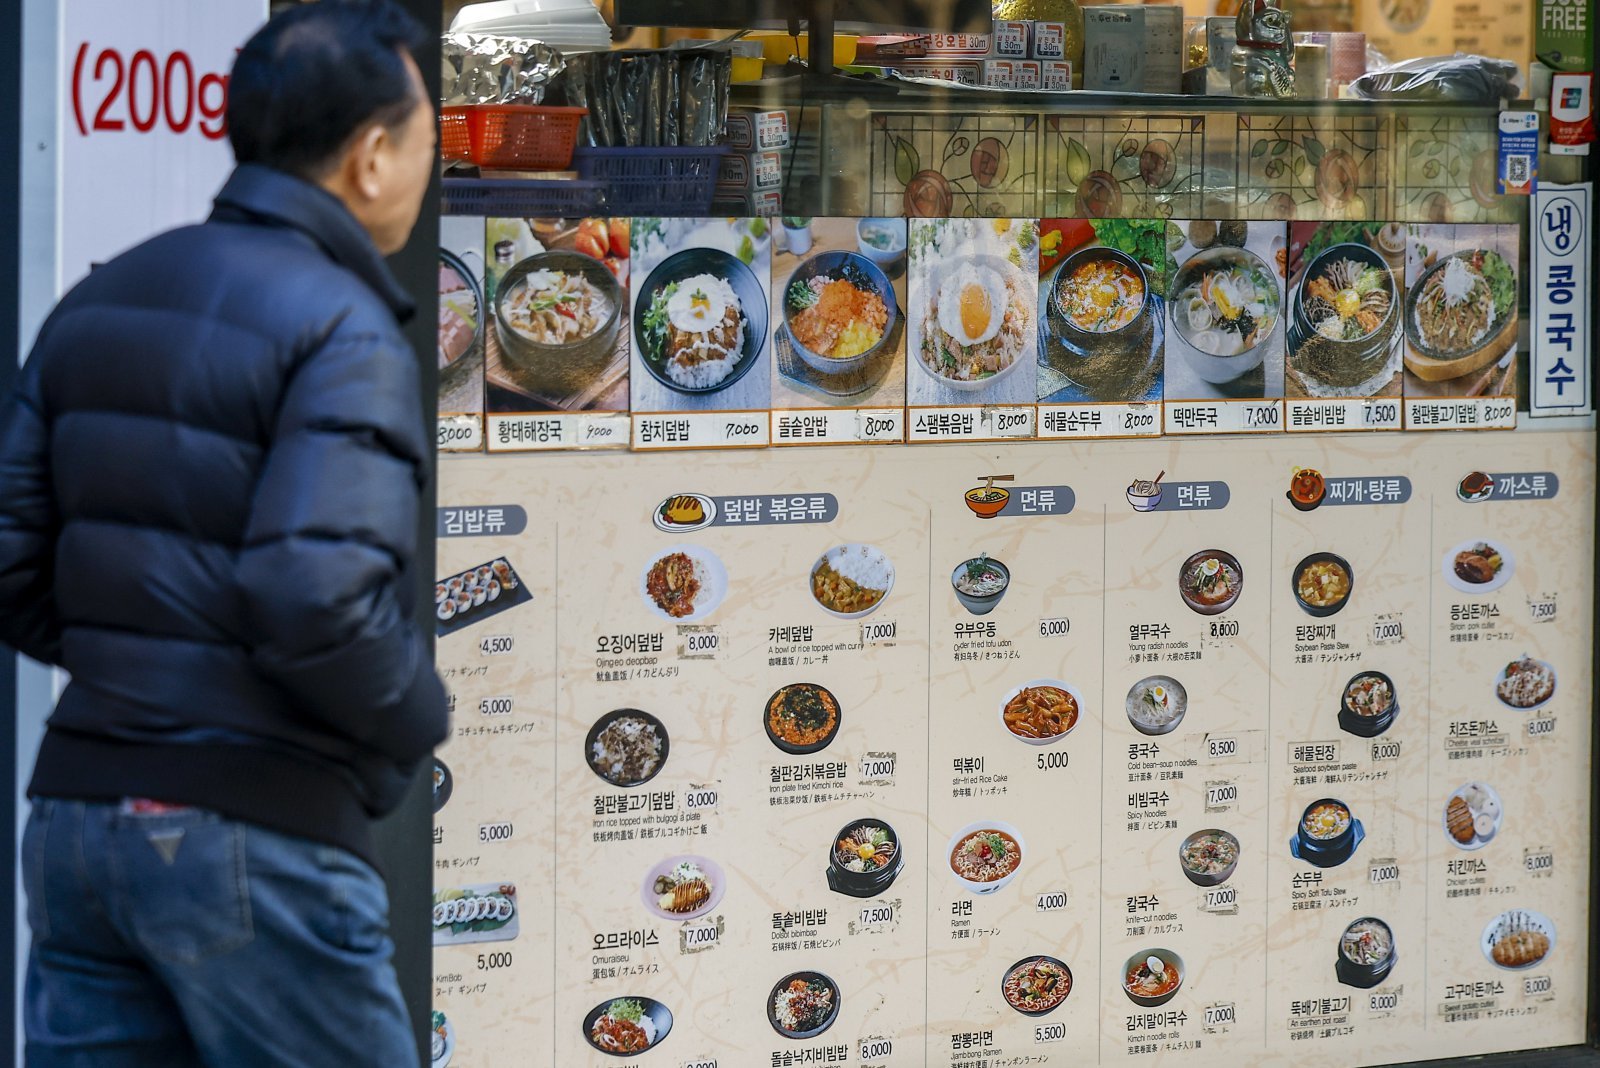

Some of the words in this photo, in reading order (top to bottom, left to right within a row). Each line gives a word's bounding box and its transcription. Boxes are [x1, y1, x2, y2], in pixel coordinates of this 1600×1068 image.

[1542, 6, 1586, 30] FREE
[969, 36, 986, 48] 30m
[1004, 41, 1021, 50] 30m
[1043, 42, 1059, 51] 30m
[72, 42, 241, 141] (200g
[994, 80, 1010, 88] 30m
[1020, 81, 1036, 89] 30m
[1051, 82, 1067, 90] 30m
[767, 133, 783, 142] 30m
[762, 172, 779, 181] 30m
[1545, 205, 1571, 250] 냉
[1545, 264, 1576, 396] 콩국수
[1044, 411, 1102, 432] 해물순두부
[1124, 412, 1154, 429] 8,000
[1173, 407, 1218, 428] 떡만두국
[1246, 408, 1278, 428] 7,000
[1292, 405, 1346, 425] 돌솥비빔밥
[1364, 405, 1397, 423] 7,500
[1411, 404, 1477, 424] 철판불고기덮밥
[498, 420, 563, 444] 황태해장국
[640, 420, 690, 442] 참치덮밥
[778, 416, 829, 438] 돌솥알밥
[865, 416, 895, 437] 8,000
[915, 414, 974, 436] 스팸볶음밥
[1499, 476, 1547, 497] 까스류
[1020, 489, 1056, 512] 면류
[1177, 485, 1212, 507] 면류
[724, 499, 762, 523] 덮밥
[769, 497, 827, 521] 볶음류
[444, 508, 506, 534] 김밥류
[1450, 603, 1500, 621] 등심돈까스
[1531, 603, 1554, 618] 7,500
[769, 625, 813, 643] 카레덮밥
[865, 624, 892, 641] 7,000
[954, 621, 997, 639] 유부우동
[1040, 620, 1067, 637] 6,000
[1129, 623, 1171, 640] 열무국수
[1295, 624, 1336, 641] 된장찌개
[1375, 624, 1399, 640] 7,000
[482, 637, 512, 654] 4,500
[596, 632, 664, 654] 오징어덮밥
[688, 635, 717, 651] 8,000
[775, 645, 789, 654] bowl
[791, 645, 797, 653] of
[798, 644, 811, 652] rice
[812, 643, 833, 654] topped
[835, 643, 847, 651] with
[970, 640, 985, 649] fried
[986, 640, 996, 648] tofu
[998, 639, 1012, 647] udon
[1129, 643, 1146, 652] Young
[1147, 642, 1164, 650] radish
[1165, 640, 1189, 649] noodles
[1295, 643, 1319, 653] Soybean
[1320, 643, 1335, 651] Paste
[1336, 642, 1350, 650] Stew
[985, 650, 1020, 660] きつねうどん
[1320, 652, 1362, 663] テンジャンチゲ
[636, 666, 680, 679] イカどんぶり
[482, 699, 512, 715] 5,000
[1449, 720, 1499, 737] 치즈돈까스
[1528, 720, 1552, 735] 8,000
[1128, 742, 1160, 760] 콩국수
[1210, 740, 1235, 756] 8,500
[1294, 744, 1336, 762] 해물된장
[770, 761, 848, 782] 철판김치볶음밥
[864, 761, 892, 778] 7,000
[953, 756, 984, 774] 떡볶이
[1037, 752, 1069, 771] 5,000
[1127, 762, 1141, 770] Cold
[1142, 760, 1174, 769] bean-soup
[1174, 758, 1198, 767] noodles
[1293, 765, 1317, 774] Seafood
[1317, 763, 1341, 772] soybean
[769, 784, 781, 793] Iron
[782, 783, 796, 793] plate
[797, 781, 811, 791] fried
[812, 780, 832, 790] Kimchi
[832, 781, 844, 789] rice
[979, 775, 992, 784] Rice
[993, 774, 1008, 783] Cake
[593, 791, 676, 815] 철판불고기덮밥
[687, 791, 716, 808] 8,000
[1128, 790, 1170, 808] 비빔국수
[1209, 786, 1234, 803] 7,000
[606, 818, 618, 827] rice
[619, 816, 641, 828] topped
[642, 815, 655, 824] with
[656, 813, 679, 825] bulgogi
[686, 812, 701, 823] plate
[1127, 811, 1143, 820] Spicy
[1144, 810, 1167, 818] Noodles
[480, 825, 510, 842] 5,000
[1447, 859, 1487, 875] 치킨까스
[1527, 856, 1551, 870] 8,000
[1292, 871, 1323, 888] 순두부
[1372, 866, 1395, 881] 7,000
[1126, 894, 1160, 913] 칼국수
[1208, 890, 1233, 906] 7,000
[1292, 891, 1307, 900] Spicy
[951, 900, 973, 916] 라면
[1037, 894, 1064, 911] 4,000
[772, 908, 828, 929] 돌솥비빔밥
[863, 908, 890, 924] 7,500
[951, 919, 971, 927] Ramen
[1153, 912, 1178, 921] noodles
[592, 929, 660, 951] 오므라이스
[688, 927, 717, 944] 7,000
[791, 929, 818, 939] bibimbap
[977, 928, 1001, 938] ラーメン
[477, 952, 513, 971] 5,000
[592, 954, 630, 965] Omuraiseu
[622, 964, 660, 977] オムライス
[1444, 981, 1504, 999] 고구마돈까스
[1525, 980, 1549, 994] 8,000
[1291, 996, 1351, 1016] 뚝배기불고기
[1370, 996, 1394, 1010] 8,000
[1126, 1010, 1188, 1031] 김치말이국수
[1207, 1007, 1232, 1024] 7,000
[951, 1030, 993, 1049] 짬뽕라면
[1035, 1025, 1062, 1041] 5,500
[1127, 1033, 1146, 1043] Kimchi
[1146, 1032, 1167, 1041] noodle
[771, 1044, 849, 1067] 돌솥낙지비빔밥
[862, 1042, 889, 1060] 8,000
[983, 1048, 1003, 1057] Ramen
